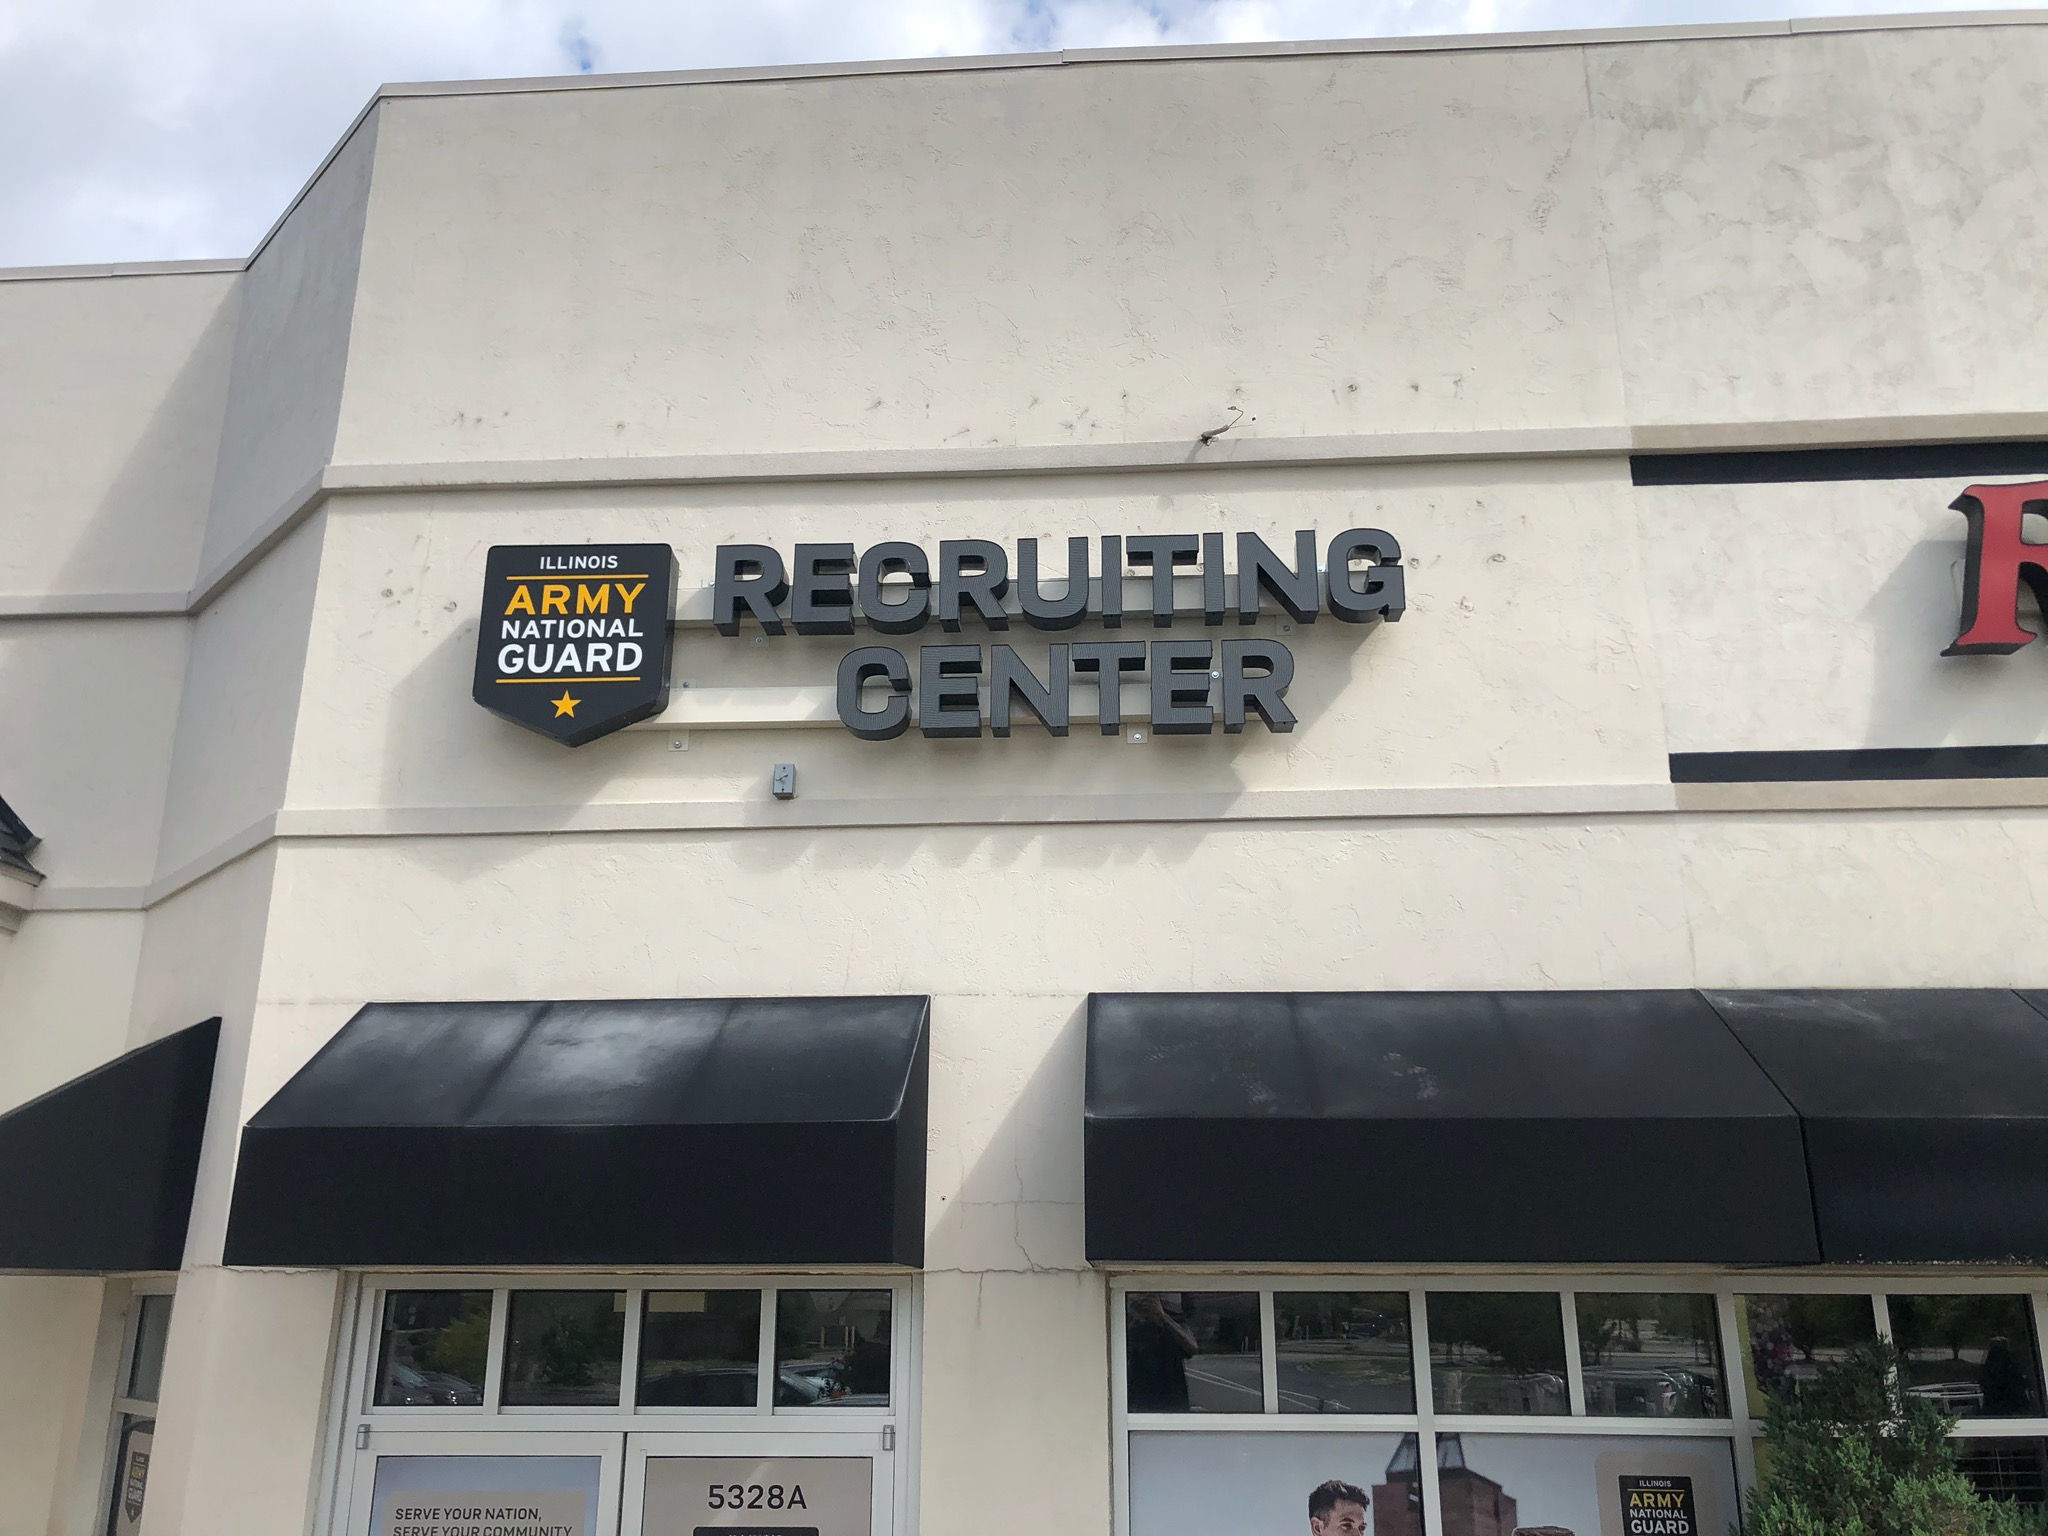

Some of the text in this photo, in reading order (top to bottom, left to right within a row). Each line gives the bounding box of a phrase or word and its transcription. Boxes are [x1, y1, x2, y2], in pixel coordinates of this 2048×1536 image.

[539, 555, 619, 571] ILLINOIS
[712, 527, 1406, 637] RECRUITING
[504, 582, 647, 616] ARMY
[501, 618, 644, 640] NATIONAL
[497, 642, 643, 675] GUARD
[836, 638, 1298, 741] CENTER
[1639, 1479, 1672, 1488] ILLINOIS
[708, 1484, 808, 1510] 5328A
[1629, 1492, 1685, 1508] ARMY
[395, 1508, 542, 1522] SERVE YOUR NATION,
[1629, 1508, 1688, 1519] NATIONAL
[393, 1526, 573, 1536] SERVE YOUR COMMUNITY
[1630, 1519, 1690, 1535] GUARD
